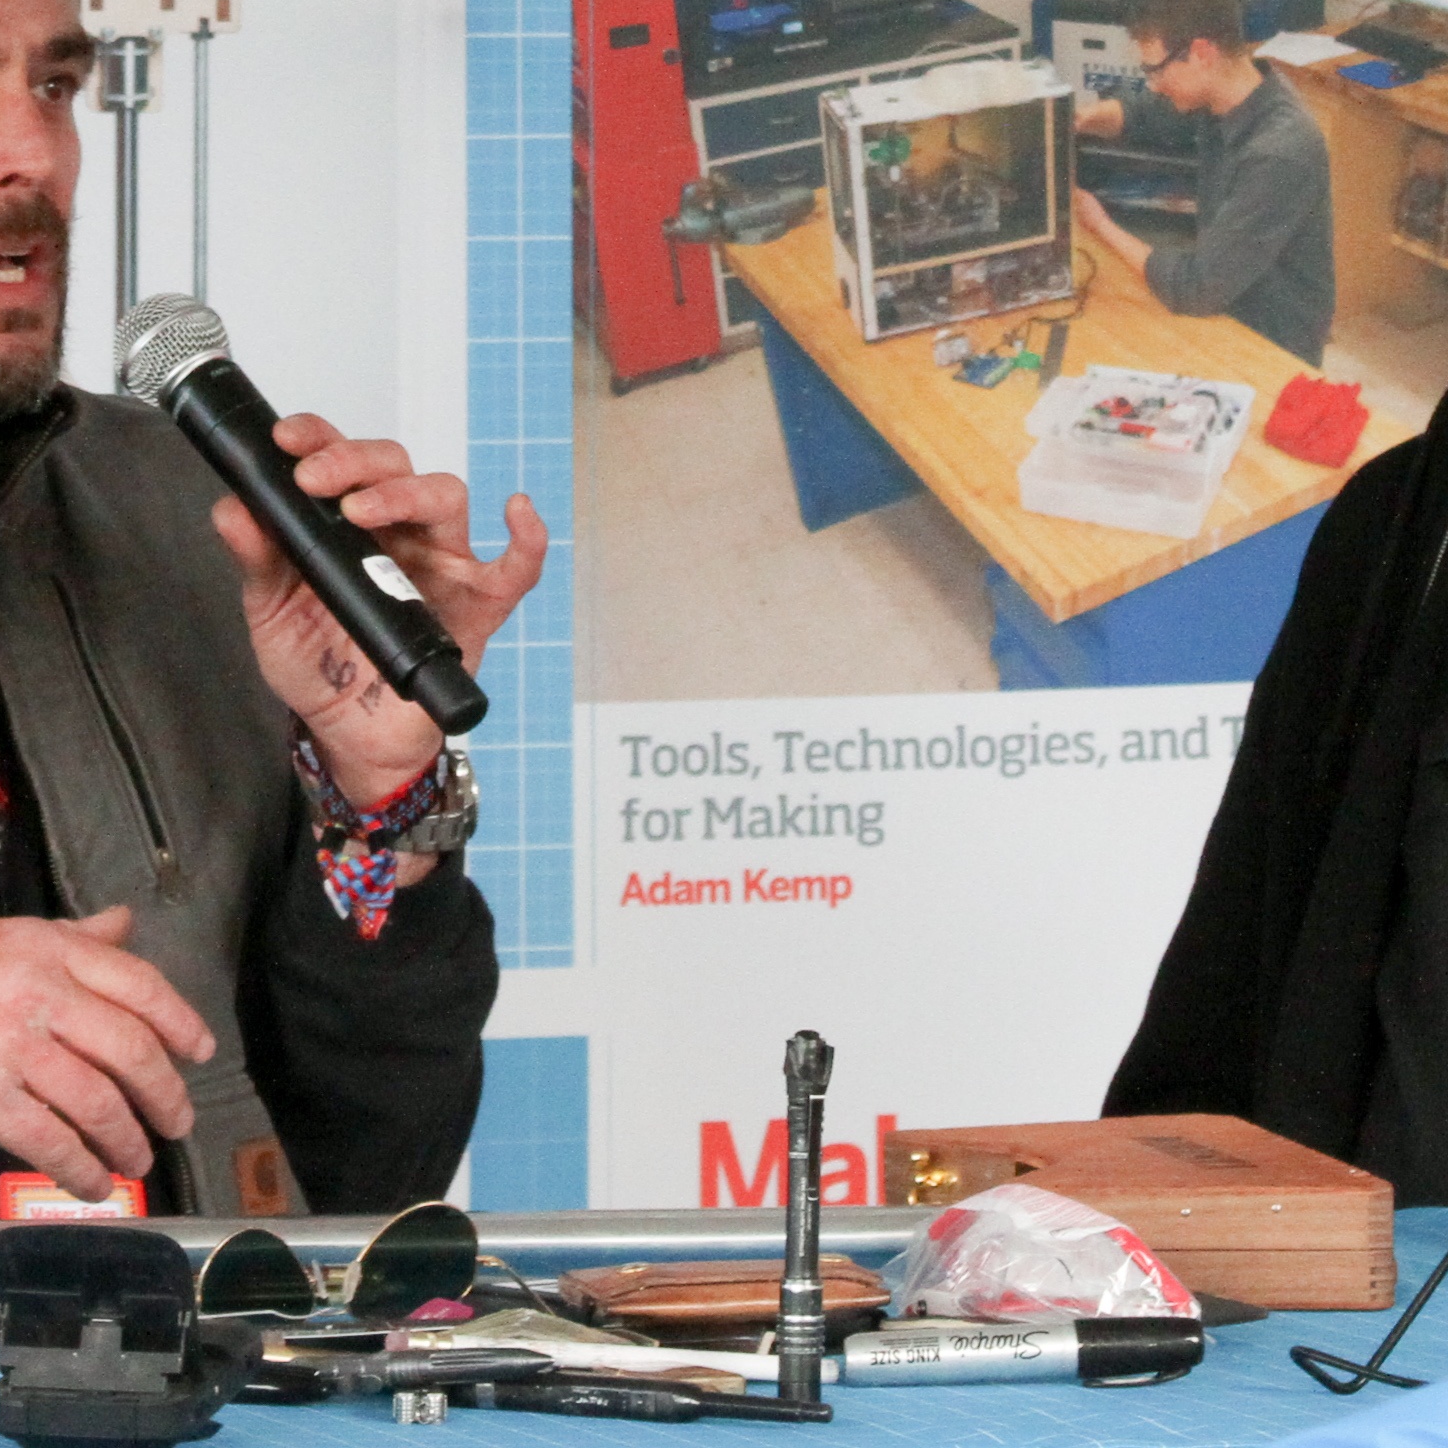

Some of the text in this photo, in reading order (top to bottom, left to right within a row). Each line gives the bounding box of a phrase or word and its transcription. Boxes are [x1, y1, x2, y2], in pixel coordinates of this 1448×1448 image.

[621, 732, 761, 779] Tools,
[774, 724, 1106, 777] Technologies,
[1121, 716, 1207, 760] and
[620, 795, 884, 846] for Making
[621, 869, 853, 908] Adam Kemp
[869, 1350, 901, 1366] SIZE
[905, 1347, 941, 1365] KING
[948, 1330, 1050, 1361] Sharpie
